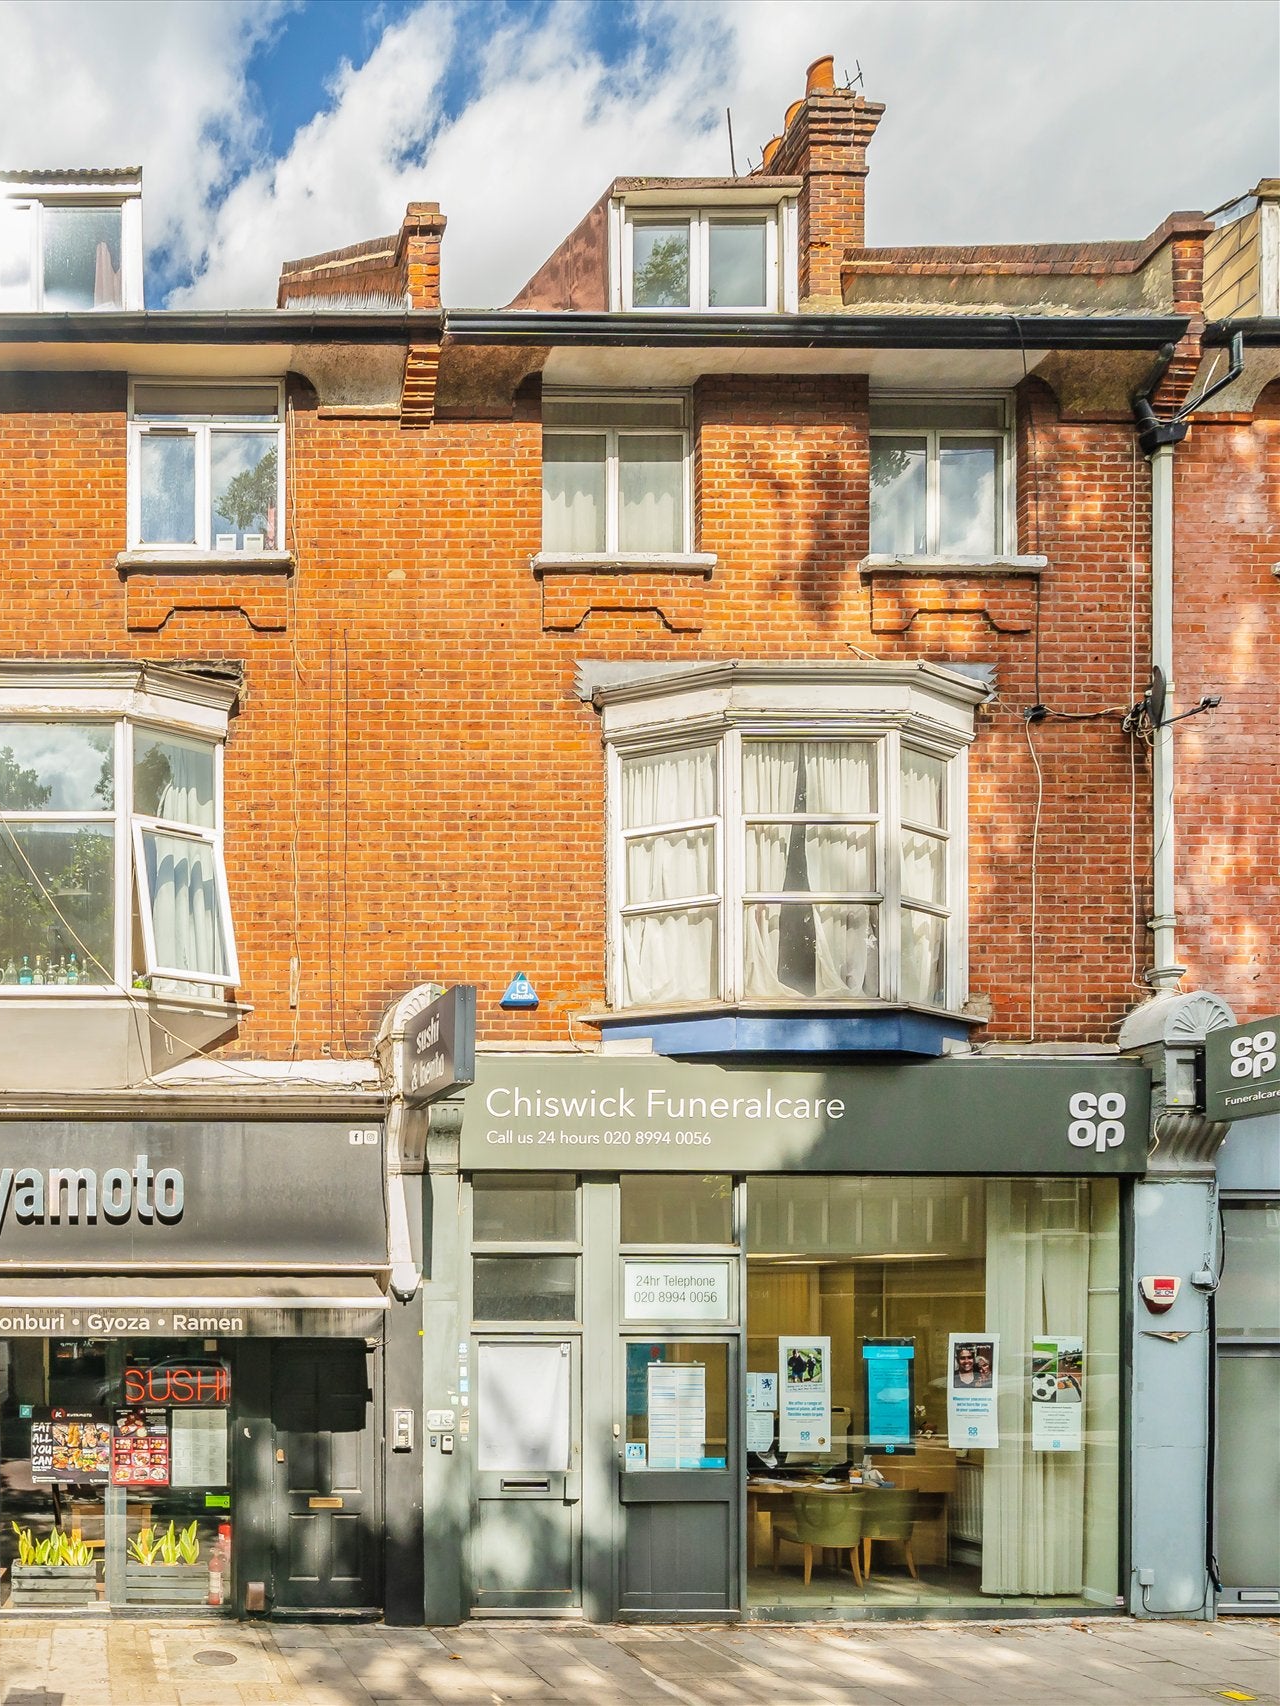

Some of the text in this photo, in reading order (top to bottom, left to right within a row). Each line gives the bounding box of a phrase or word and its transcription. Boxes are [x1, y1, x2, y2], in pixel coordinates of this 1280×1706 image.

[416, 1012, 440, 1054] sushi
[419, 1051, 445, 1088] bento
[485, 1087, 846, 1119] Chiswick Funeralcare
[486, 1130, 712, 1146] Call us 24 hours 020 8994 0056
[635, 1274, 716, 1288] 24hr Telephone
[633, 1291, 718, 1303] 020 8994 0056
[87, 1314, 151, 1333] Gyoza
[173, 1314, 243, 1331] Ramen
[124, 1369, 227, 1402] SUSHI
[32, 1422, 52, 1433] EAT
[32, 1433, 53, 1444] ALL
[32, 1445, 52, 1455] YOU
[32, 1456, 53, 1466] CAN
